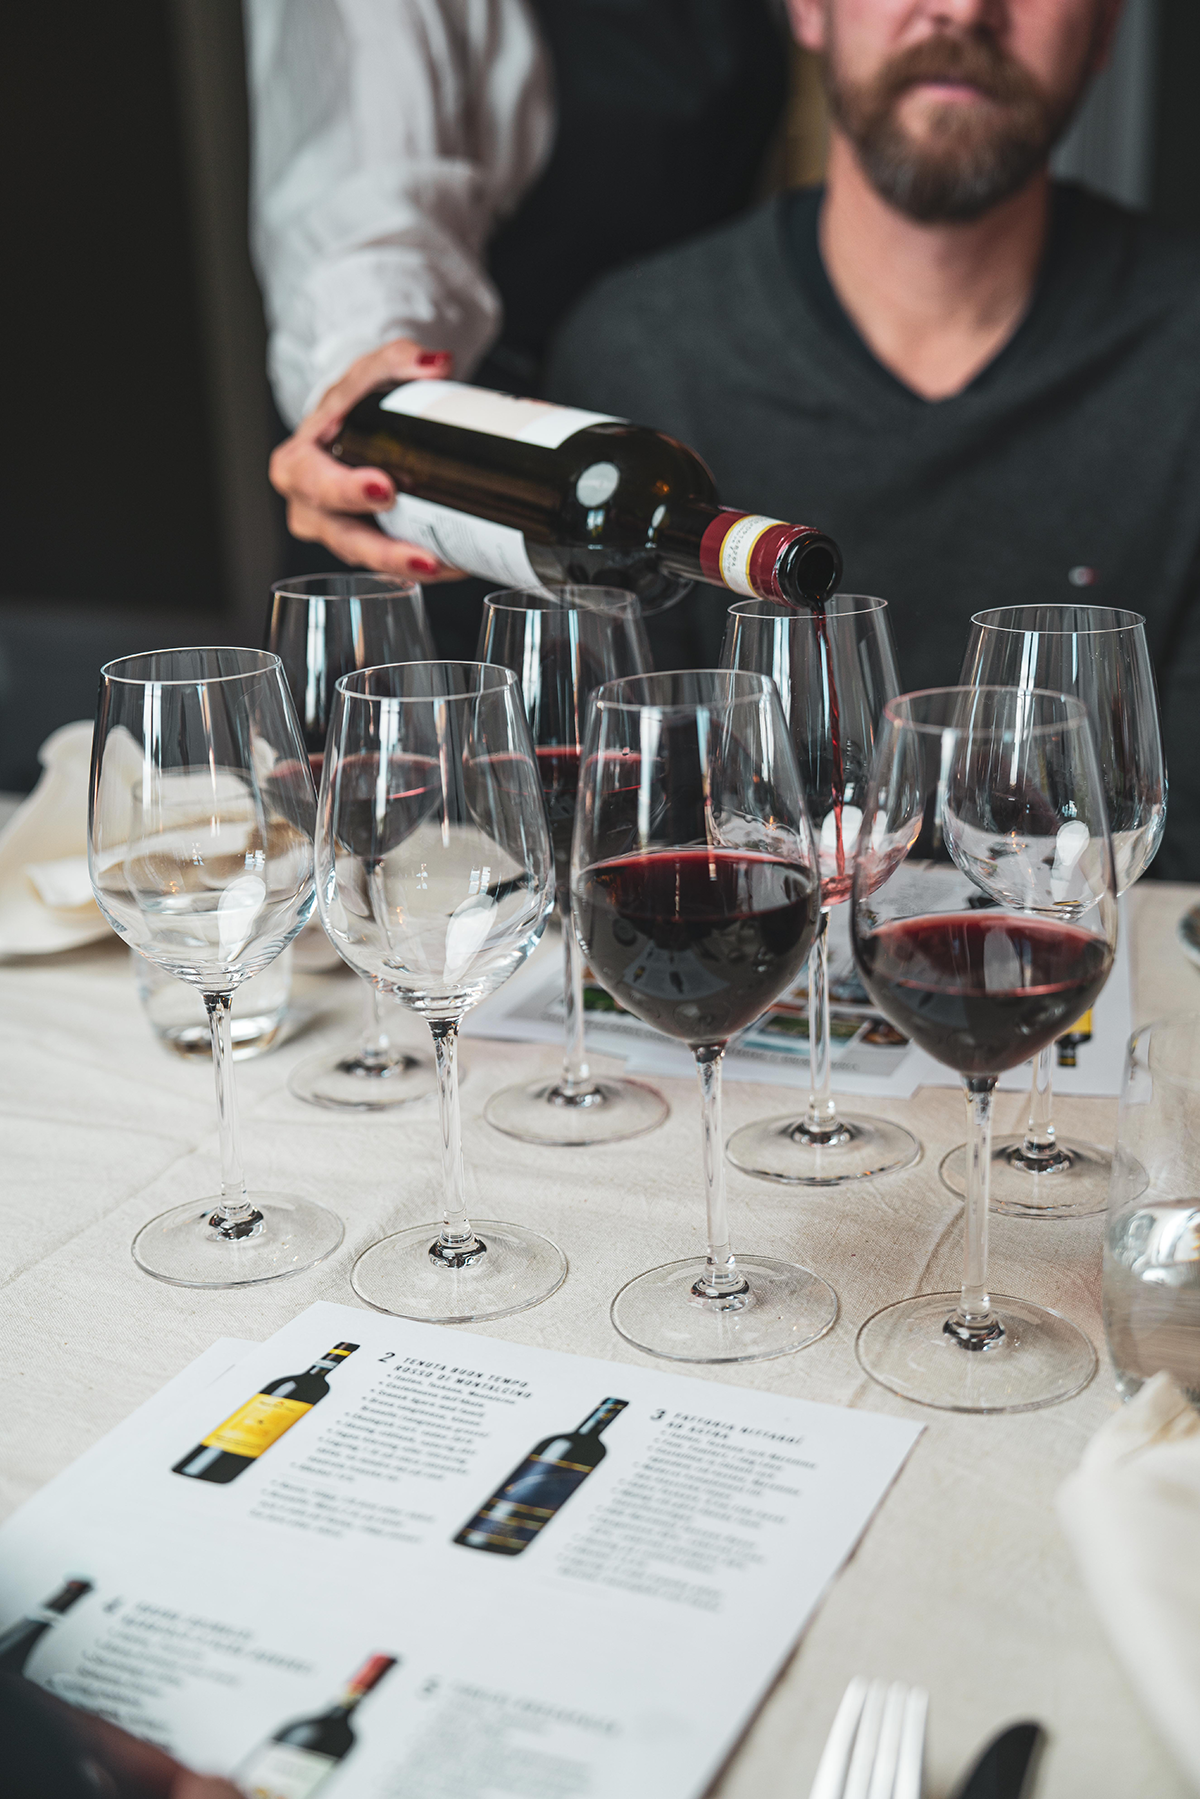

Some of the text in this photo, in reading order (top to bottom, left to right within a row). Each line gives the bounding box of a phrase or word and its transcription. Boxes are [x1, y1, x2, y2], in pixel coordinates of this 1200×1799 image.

[378, 1352, 395, 1363] 2
[394, 1365, 532, 1398] ROSSO DI MONTALCINO
[403, 1357, 447, 1371] TENUTA
[488, 1374, 529, 1388] TEMPO
[650, 1408, 666, 1421] 3
